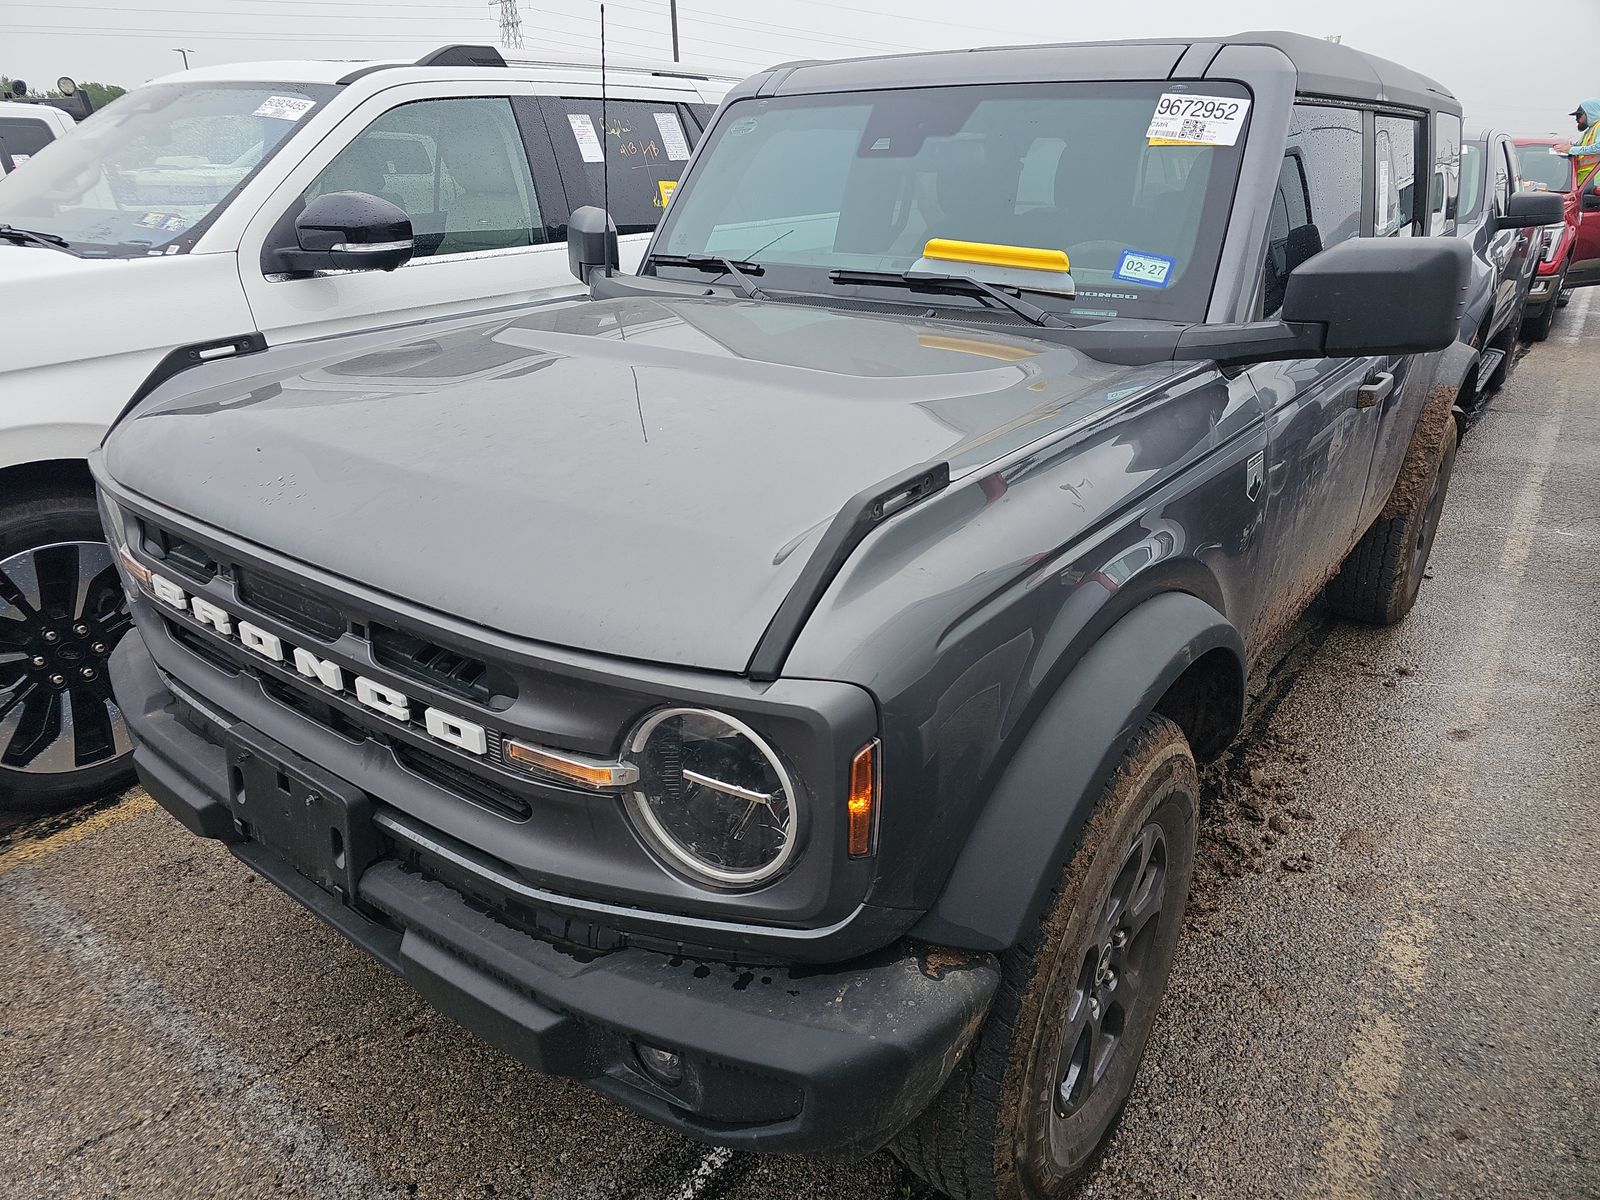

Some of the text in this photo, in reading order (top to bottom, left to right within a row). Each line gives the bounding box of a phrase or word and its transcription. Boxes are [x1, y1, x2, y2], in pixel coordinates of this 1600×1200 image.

[1158, 98, 1239, 120] 9672952
[1126, 260, 1166, 276] 02 27
[151, 573, 487, 755] BRONCO
